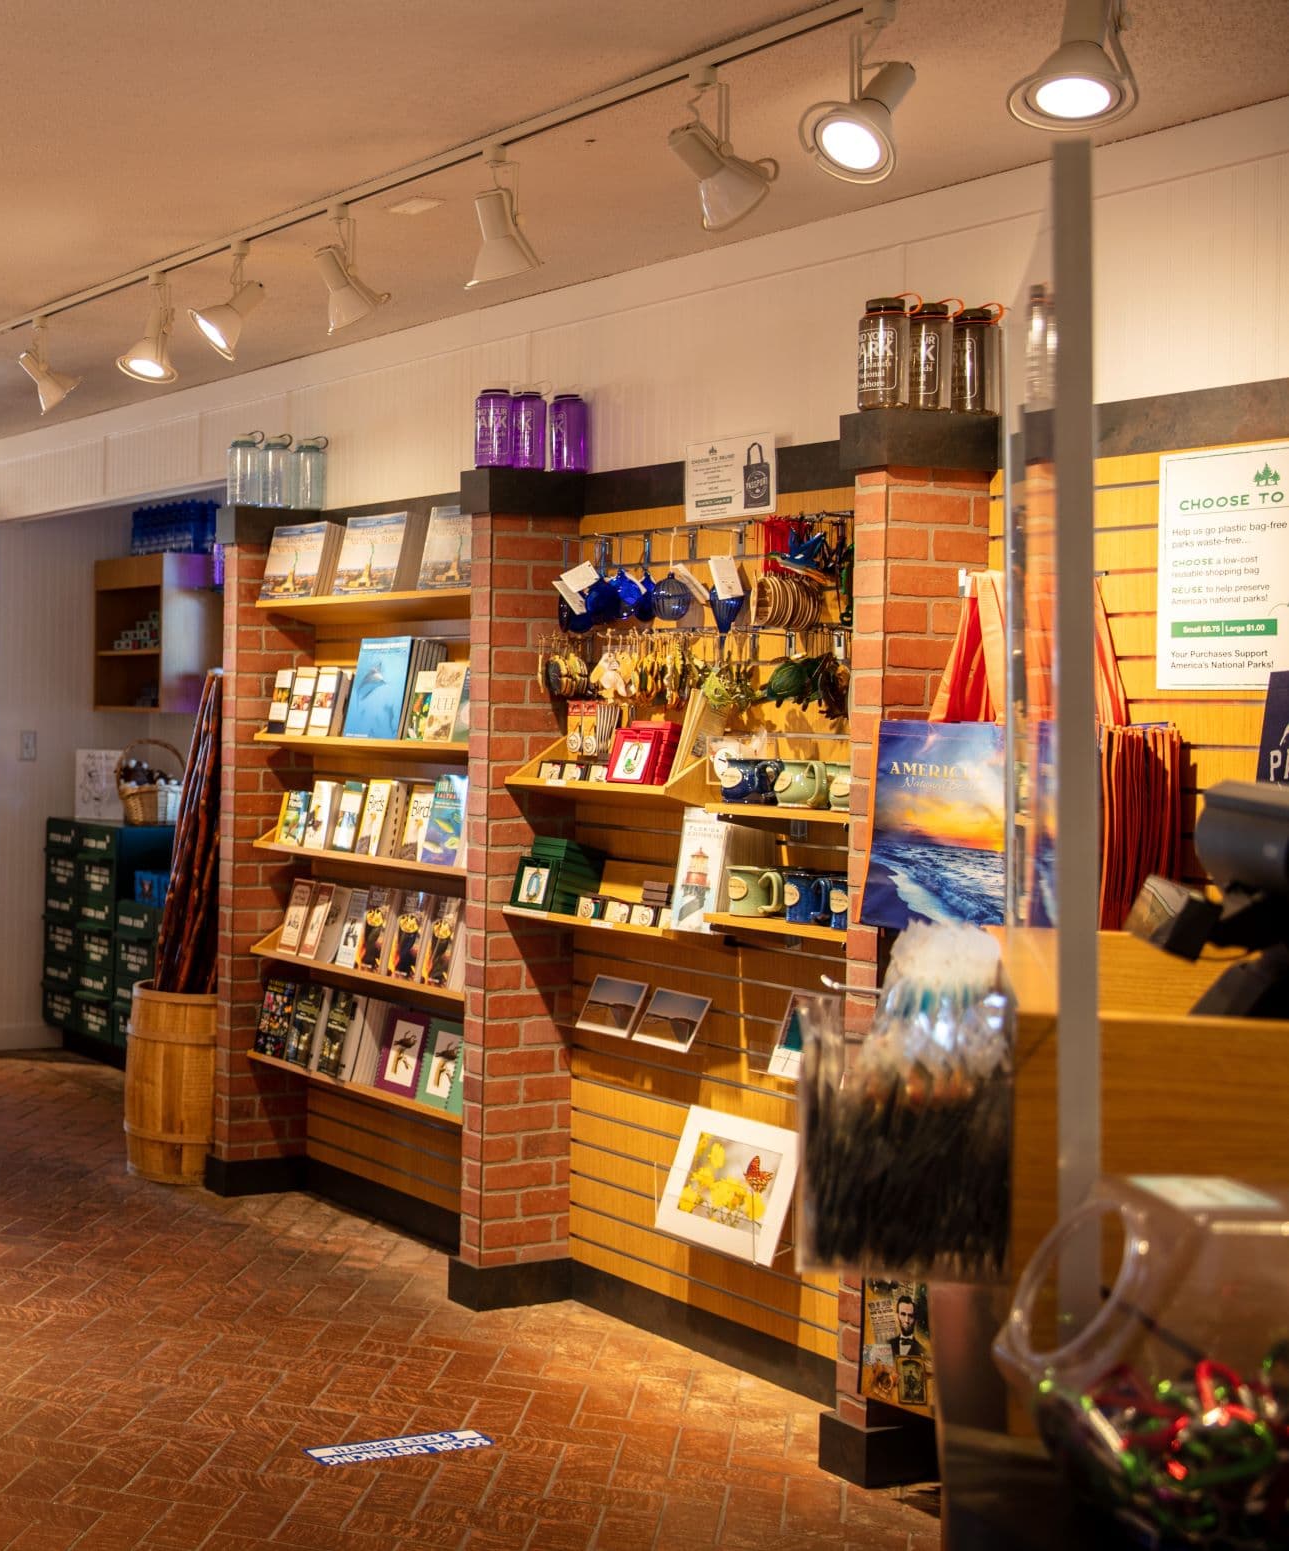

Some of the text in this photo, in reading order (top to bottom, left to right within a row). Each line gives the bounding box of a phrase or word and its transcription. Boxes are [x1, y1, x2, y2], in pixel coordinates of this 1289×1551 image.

[859, 340, 894, 358] ARK
[479, 416, 507, 428] ARK
[1179, 491, 1285, 511] CHOOSE TO
[1172, 528, 1191, 536] Help
[1205, 527, 1216, 536] go
[1218, 524, 1247, 535] plastic
[1249, 521, 1288, 532] bag-free
[1172, 540, 1195, 549] parks
[1172, 558, 1214, 567] CHOOSE
[1223, 556, 1258, 565] low-cost
[1171, 566, 1260, 578] reusable shopping bag
[1172, 586, 1203, 594] REUSE
[1215, 584, 1232, 594] help
[1235, 583, 1270, 593] preserve
[1209, 596, 1241, 604] national
[1243, 594, 1268, 604] parks!
[1182, 625, 1201, 633] Small
[1225, 625, 1245, 633] Large
[1171, 650, 1268, 659] Your Purchases Support
[1171, 660, 1274, 669] America's National Parks!
[411, 799, 431, 818] Bird
[401, 1436, 437, 1446] FEET
[439, 1432, 458, 1441] 6
[322, 1437, 491, 1466] SOCIAL DISTANCING
